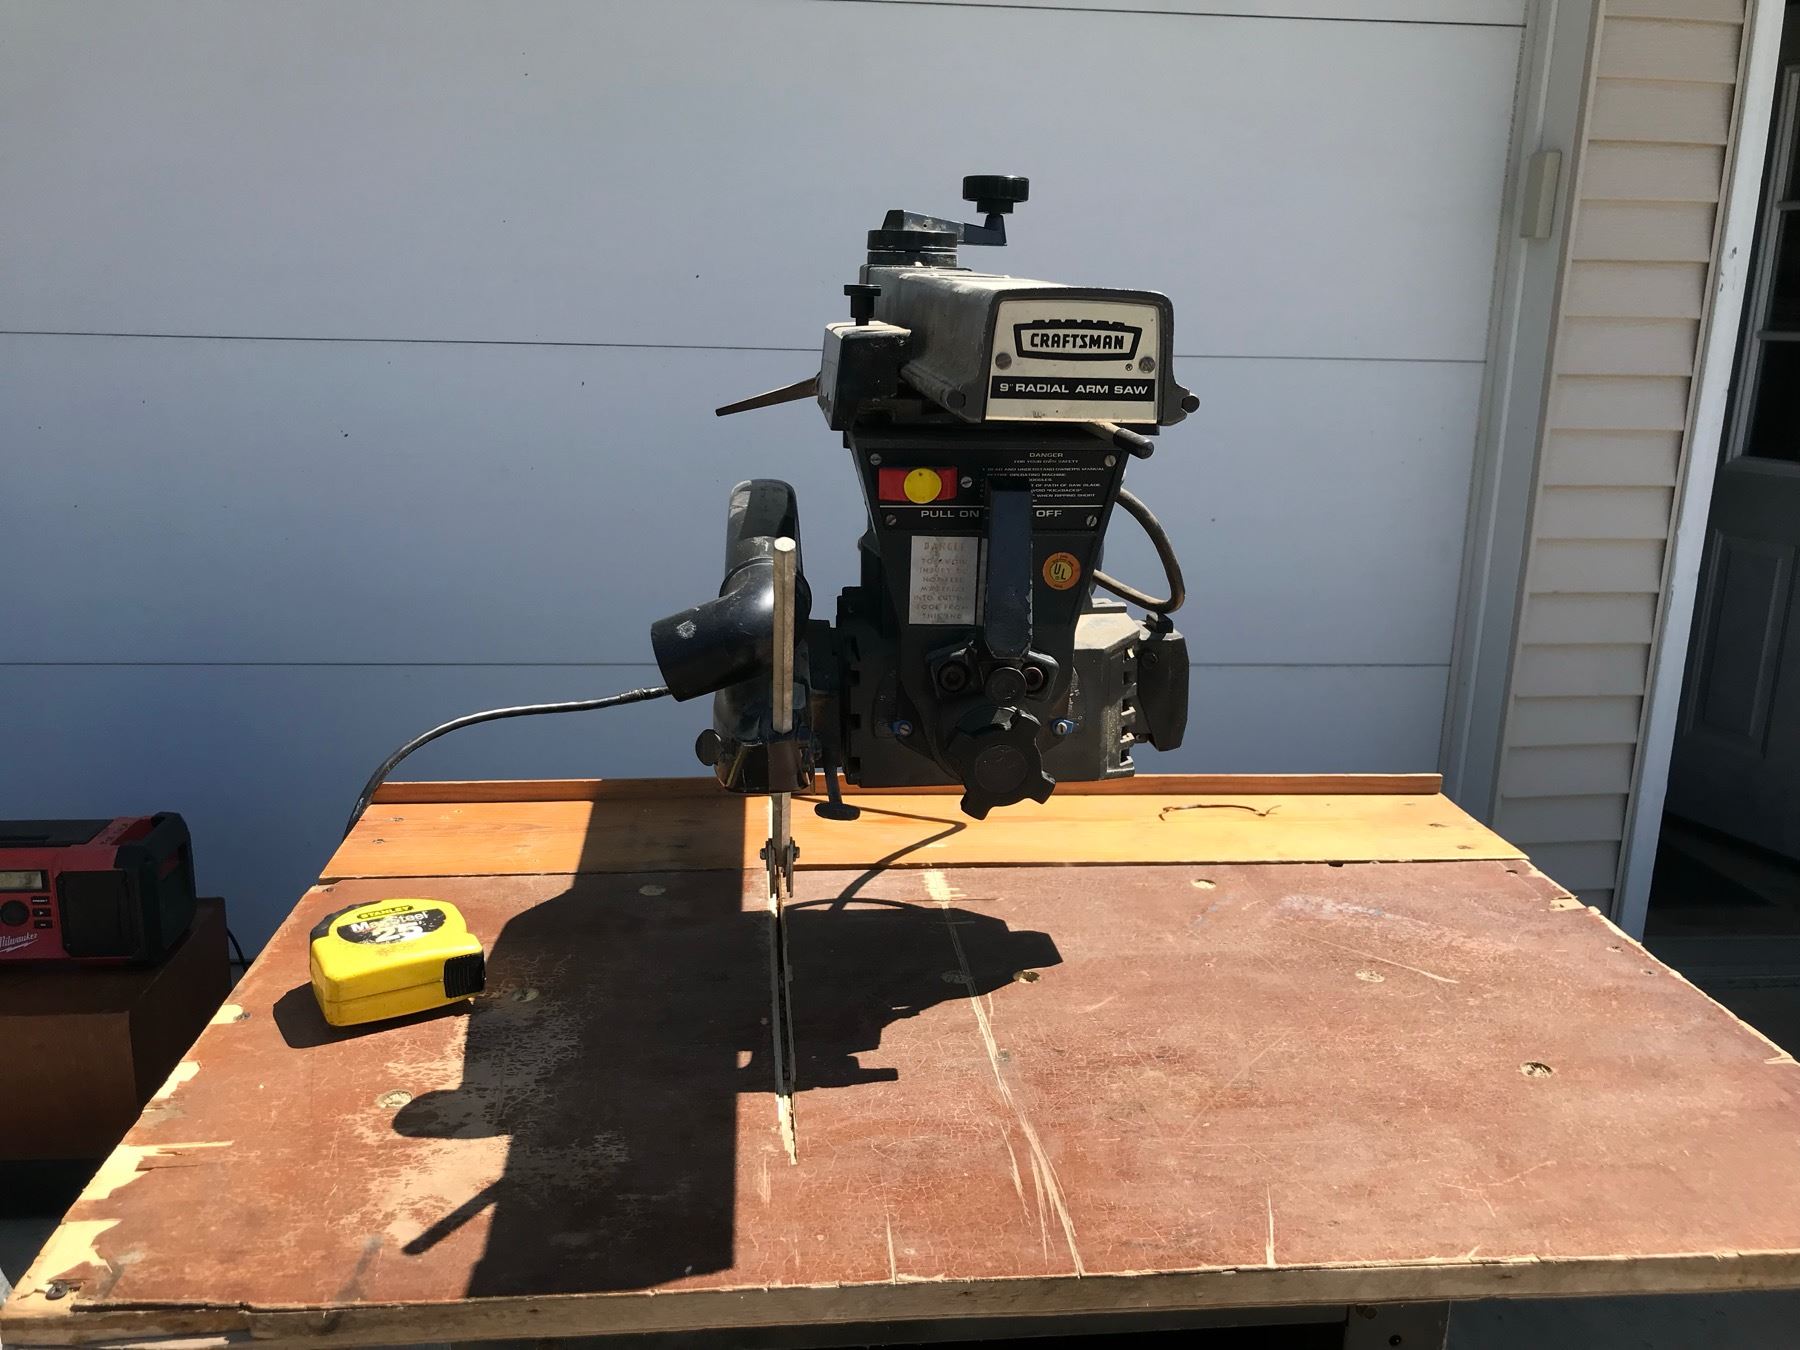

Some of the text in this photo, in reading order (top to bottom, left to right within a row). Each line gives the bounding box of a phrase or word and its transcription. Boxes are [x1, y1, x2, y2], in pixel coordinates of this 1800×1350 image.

[1030, 333, 1124, 349] CRAFTSMAN
[1015, 383, 1069, 393] RADIAL
[1075, 385, 1109, 394] ARM
[1114, 385, 1148, 395] SAW
[920, 509, 1062, 518] PULL ON OFF
[361, 905, 410, 919] STANLEY
